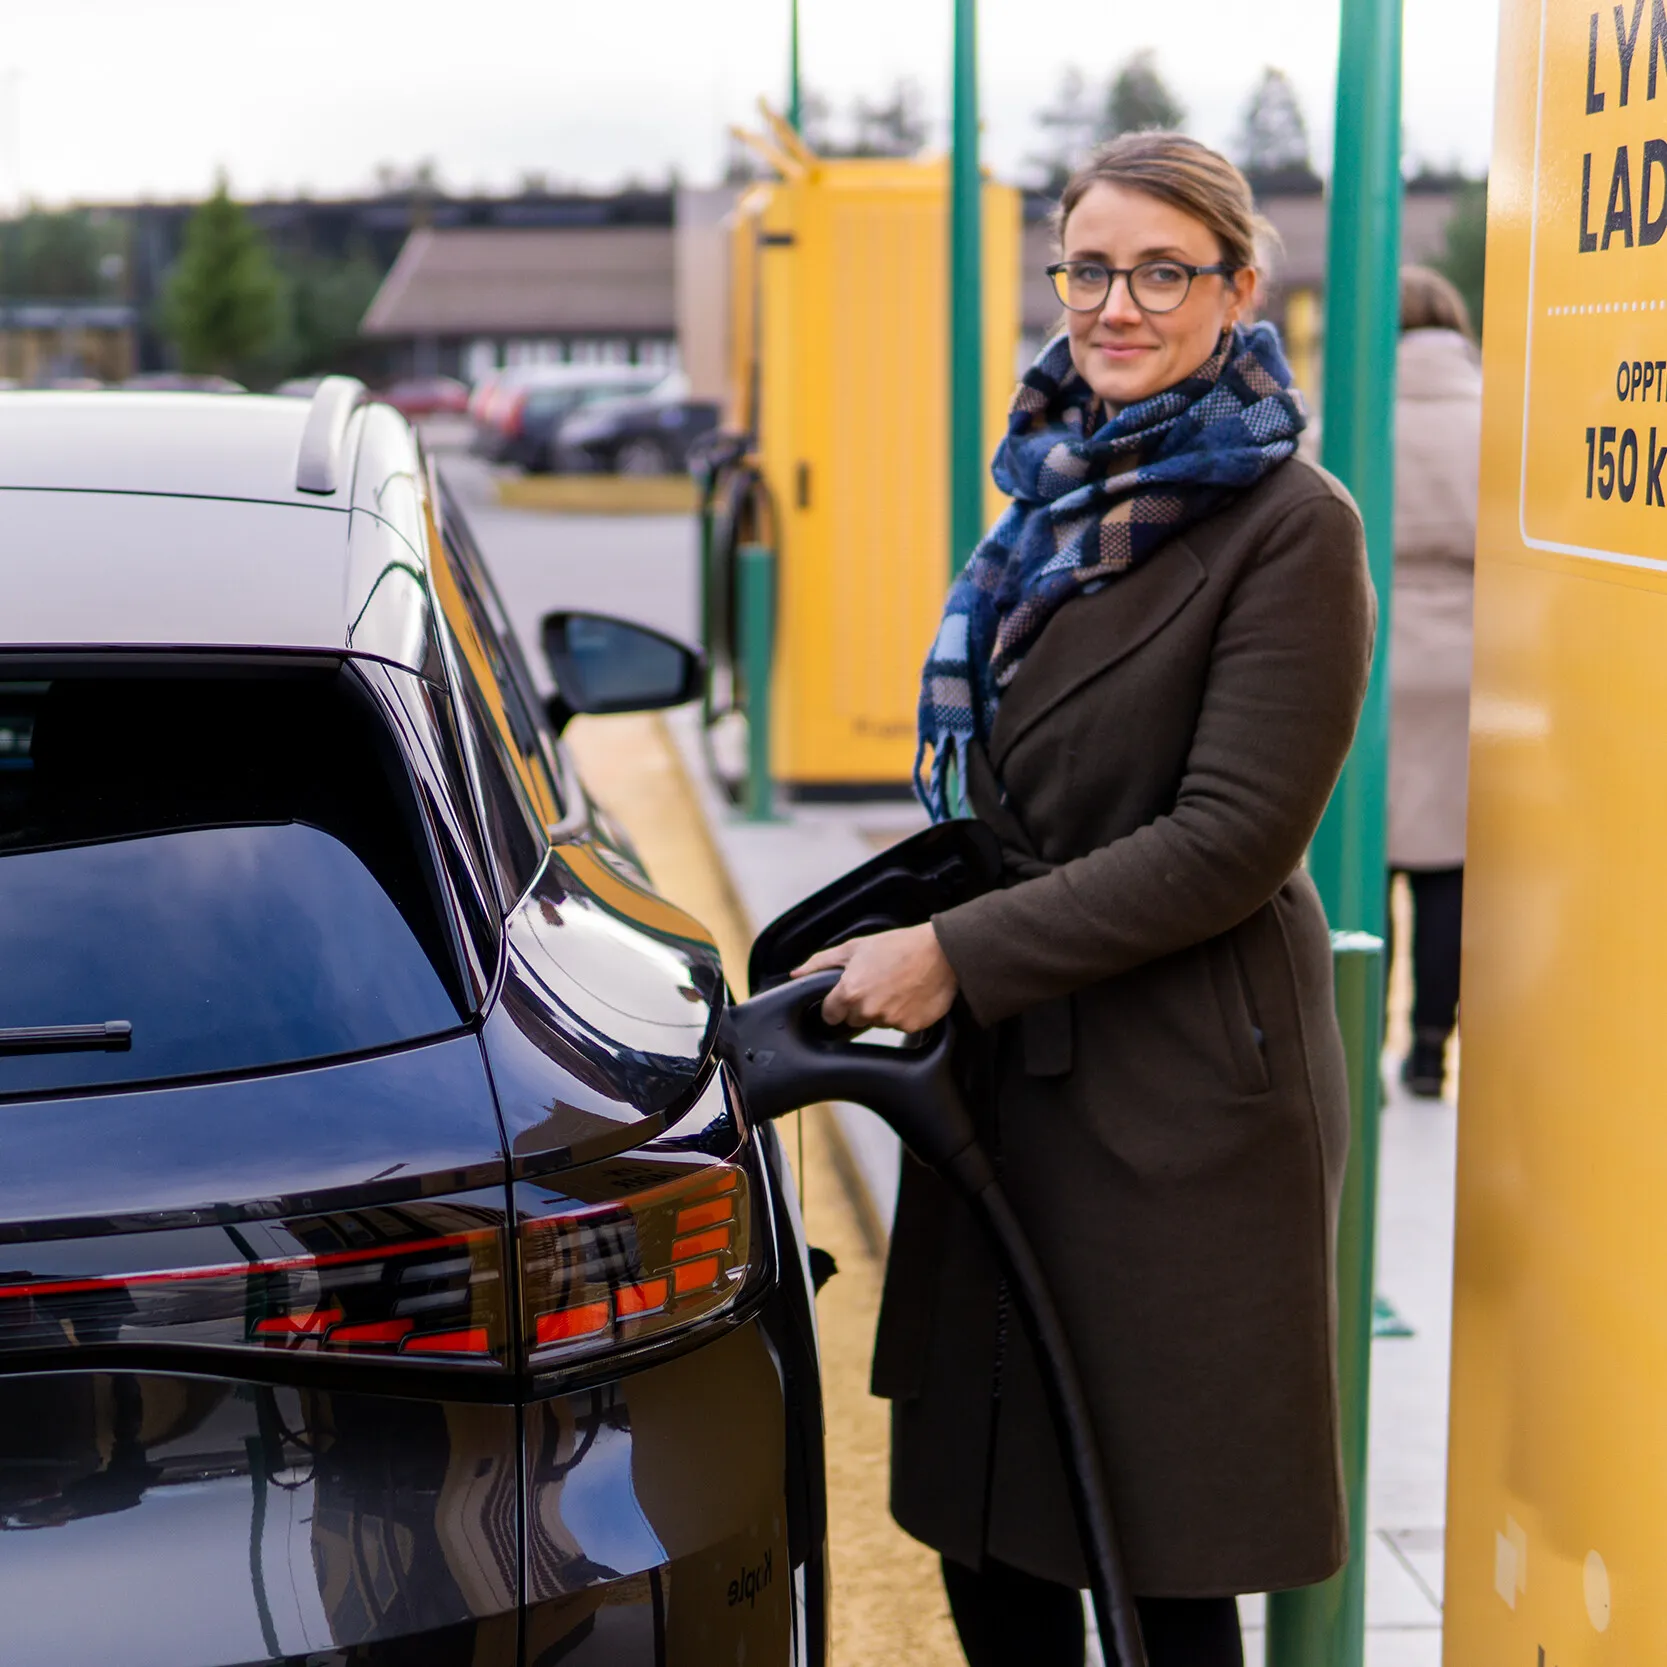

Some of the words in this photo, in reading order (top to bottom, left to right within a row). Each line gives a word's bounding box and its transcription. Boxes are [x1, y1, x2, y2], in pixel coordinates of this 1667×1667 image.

[1578, 138, 1667, 254] LAD
[1616, 360, 1667, 402] OPPT
[1585, 426, 1638, 503] 150
